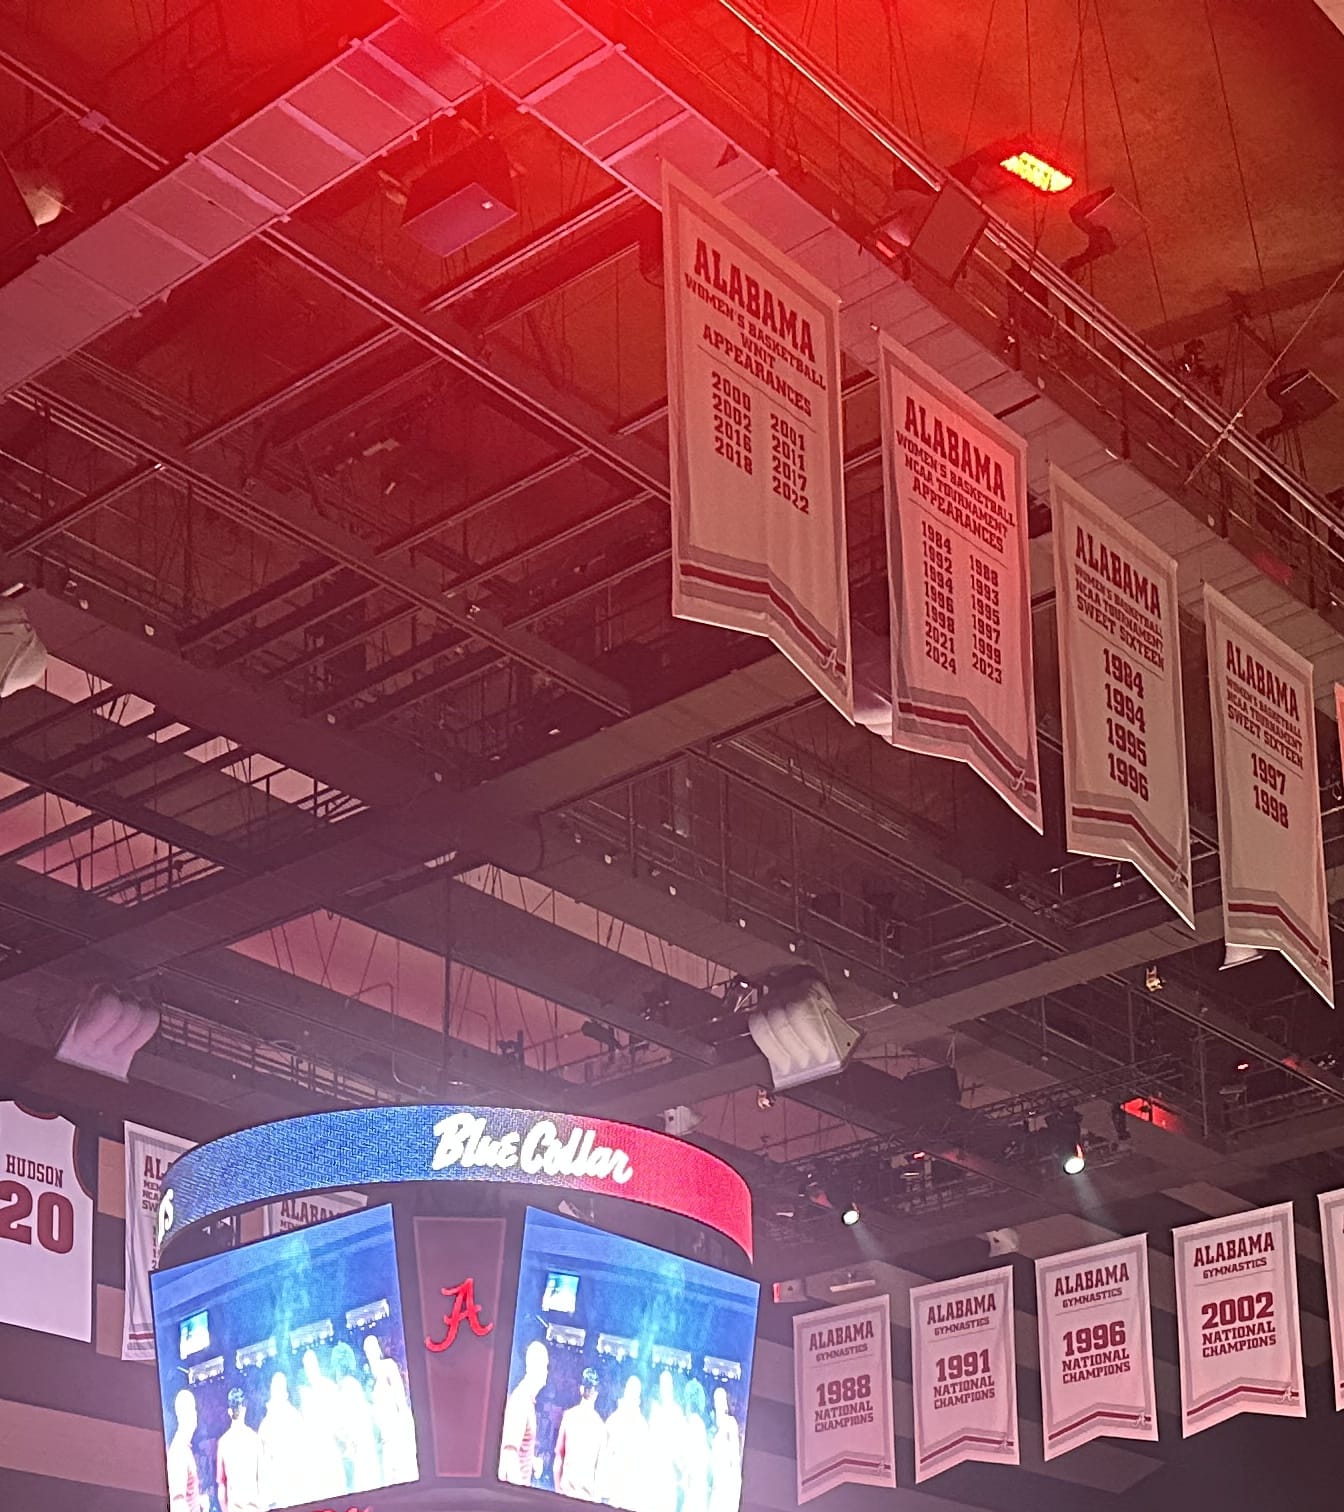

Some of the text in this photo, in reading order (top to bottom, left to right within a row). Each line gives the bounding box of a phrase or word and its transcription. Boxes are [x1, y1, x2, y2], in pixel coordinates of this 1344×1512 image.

[694, 237, 815, 363] ALABAMA
[904, 396, 1006, 502] ALABAMA
[1075, 525, 1161, 620] ALABAMA
[1103, 647, 1144, 700] 1984
[1226, 639, 1300, 722] ALABAMA
[1104, 682, 1146, 734] 1994
[1106, 717, 1147, 767] 1995
[1108, 752, 1149, 802] 1996
[1251, 752, 1286, 796] 1997
[1253, 784, 1289, 829] 1998
[431, 1112, 633, 1184] Blue Collar
[6, 1154, 63, 1188] HUDSON
[1193, 1231, 1275, 1267] ALABAMA
[1054, 1262, 1129, 1297] ALABAMA
[1202, 1256, 1267, 1279] GYMNASTICS
[927, 1292, 996, 1325] ALABAMA
[1062, 1287, 1123, 1308] GYMNASTICS
[1201, 1291, 1274, 1331] 2002
[809, 1320, 874, 1351] ALABAMA
[934, 1316, 990, 1336] GYMNASTICS
[1063, 1320, 1126, 1357] 1996
[1202, 1320, 1276, 1346] NATIONAL
[815, 1343, 868, 1362] GYMNASTICS
[1062, 1347, 1130, 1372] NATIONAL
[1202, 1334, 1277, 1358] CHAMPIONS
[936, 1348, 990, 1383] 1991
[1062, 1360, 1131, 1384] CHAMPIONS
[816, 1374, 871, 1407] 1988
[933, 1375, 995, 1398] NATIONAL
[934, 1387, 995, 1410] CHAMPIONS
[814, 1400, 874, 1422] NATIONAL
[814, 1412, 874, 1433] CHAMPIONS
